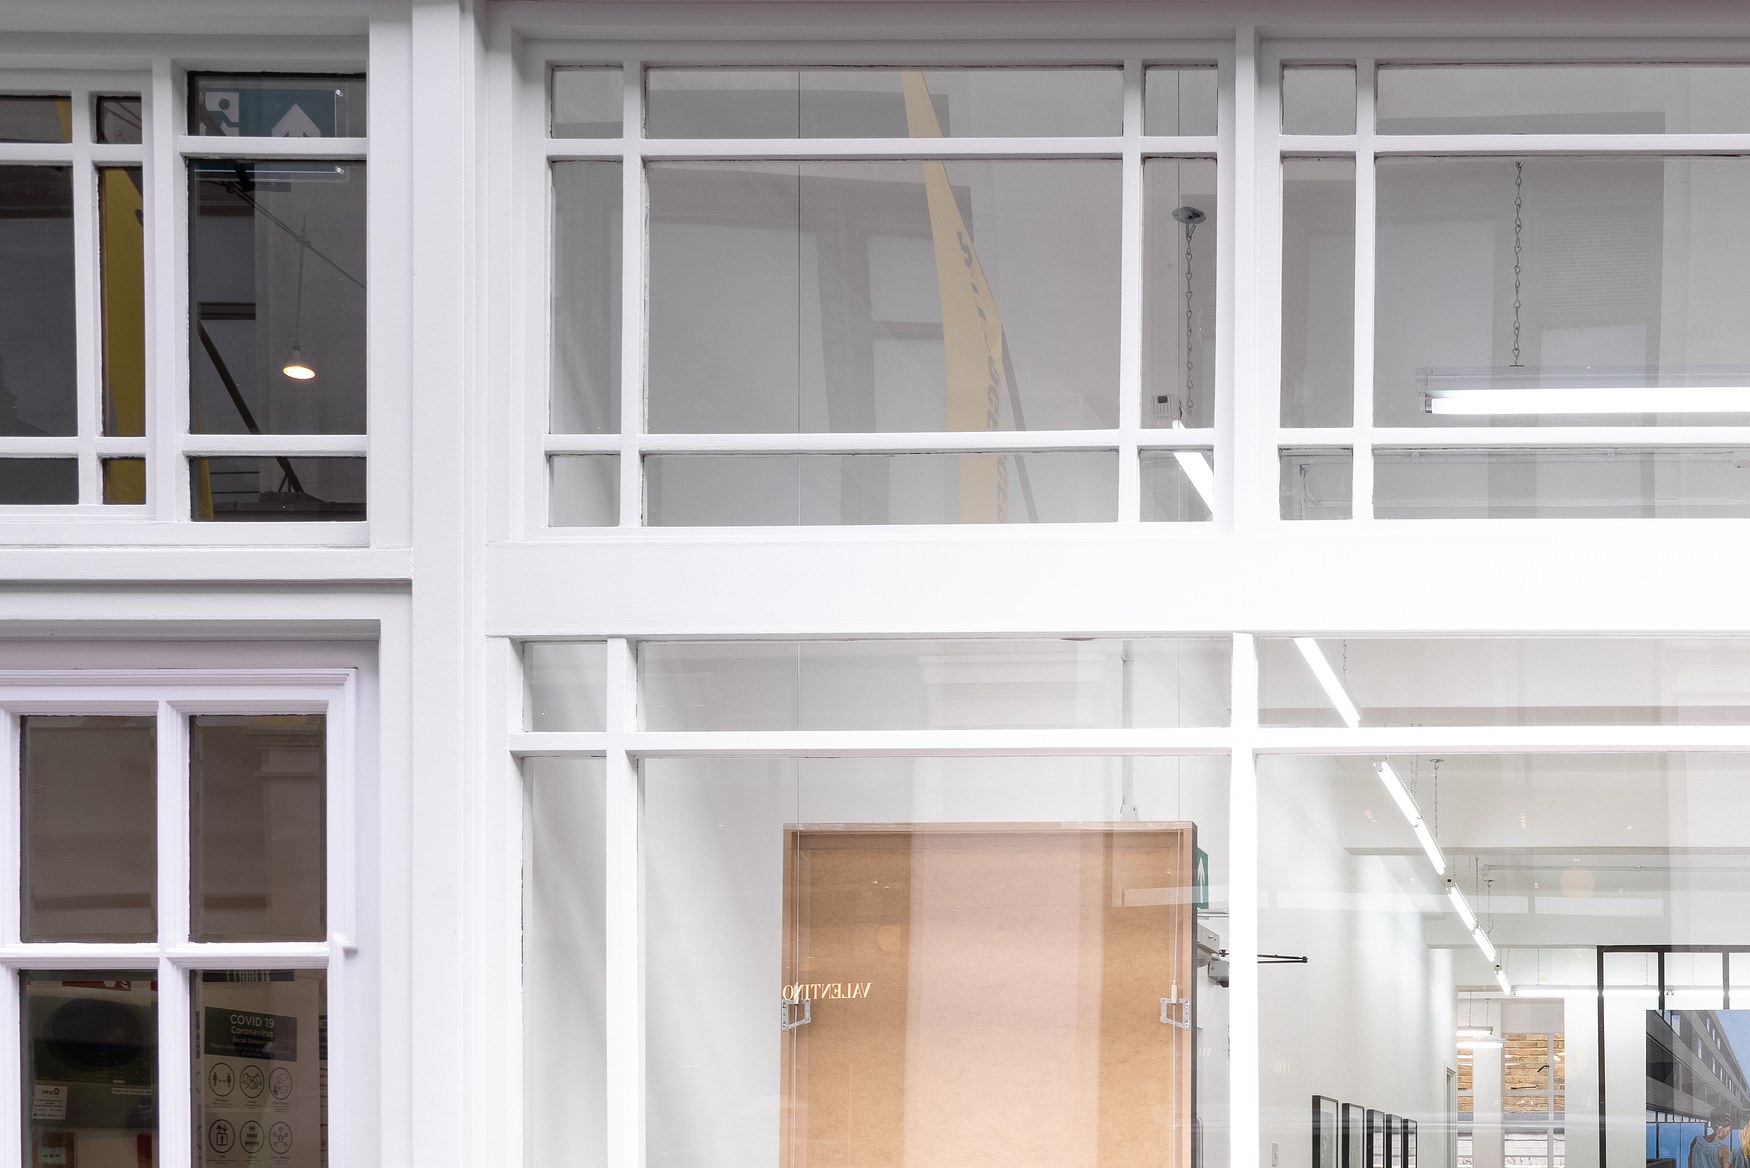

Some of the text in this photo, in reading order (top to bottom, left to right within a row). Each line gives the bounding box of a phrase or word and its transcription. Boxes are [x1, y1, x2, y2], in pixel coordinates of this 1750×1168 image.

[230, 1014, 274, 1029] COVID 19
[231, 1026, 274, 1038] Coronavirus
